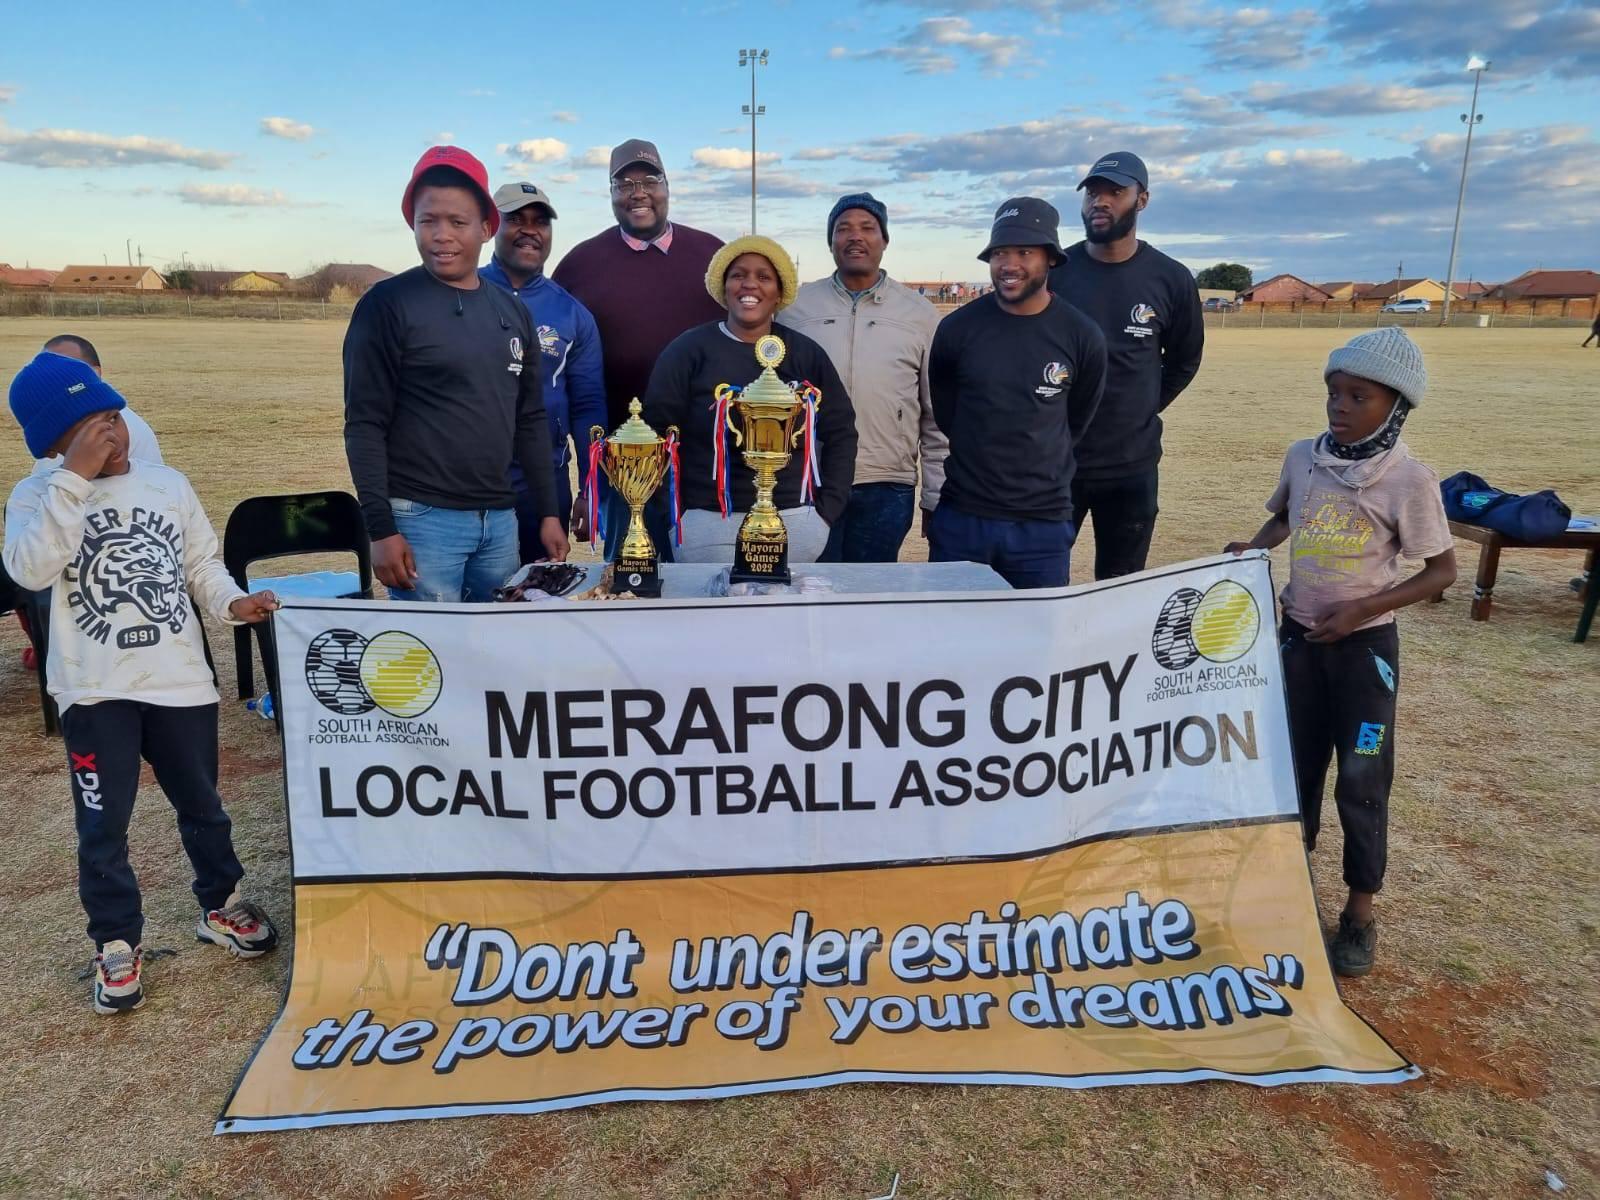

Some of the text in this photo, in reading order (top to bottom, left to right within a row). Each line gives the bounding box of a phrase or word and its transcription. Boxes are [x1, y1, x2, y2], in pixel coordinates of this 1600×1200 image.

[741, 541, 784, 554] Mayoral
[745, 552, 780, 563] Games
[750, 563, 773, 573] 2022
[67, 591, 112, 645] WILD
[123, 629, 155, 644] 1991
[1146, 677, 1269, 703] FOOTBALL ASSOCIATION
[1154, 663, 1257, 691] SOUTH AFRICAN
[485, 653, 1139, 759] MERAFONG CITY
[308, 733, 449, 747] FOOTBALL ASSOCIATION
[318, 719, 438, 735] SOUTH AFRICAN
[319, 710, 1259, 820] LOCAL FOOTBALL ASSOCIATION
[71, 752, 103, 810] RGX
[424, 922, 645, 1007] “Dont
[292, 1009, 438, 1070] the
[432, 1002, 704, 1075] power
[715, 986, 806, 1052] of
[824, 990, 999, 1044] your
[1008, 953, 1305, 1032] dreams”
